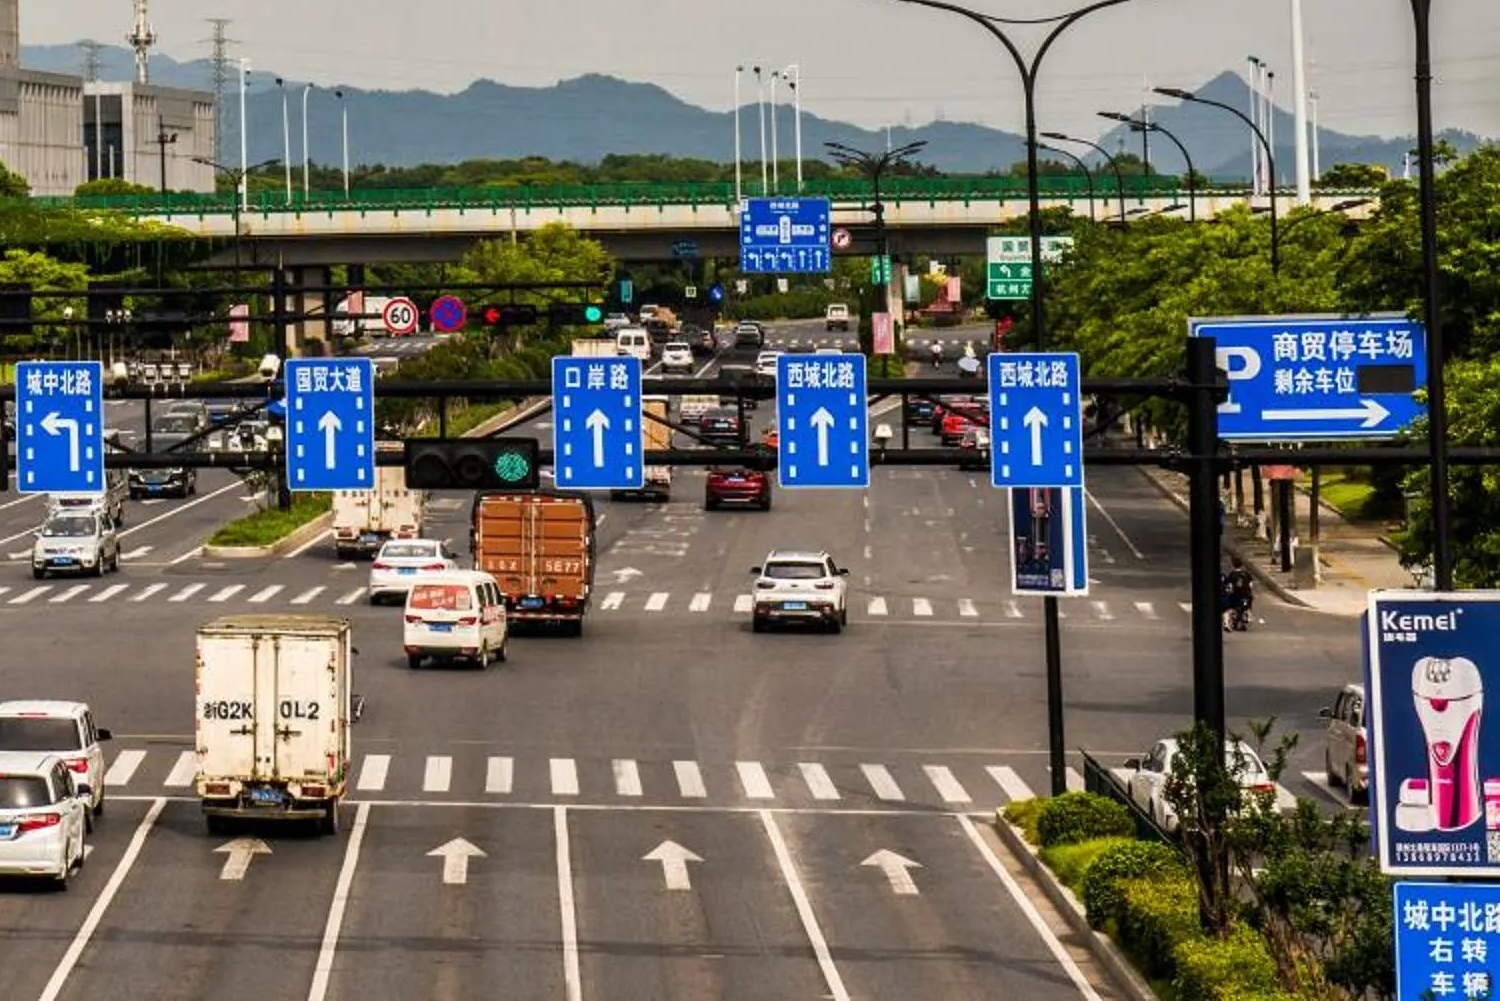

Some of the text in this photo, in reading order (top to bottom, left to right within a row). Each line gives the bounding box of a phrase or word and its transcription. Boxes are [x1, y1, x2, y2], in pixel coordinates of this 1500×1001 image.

[390, 307, 411, 324] 60
[1272, 330, 1413, 362] 商贸停车场
[26, 368, 92, 396] 城中北路
[296, 365, 362, 392] 国贸大道
[565, 363, 629, 390] 口岸路
[787, 362, 855, 388] 西城北路
[1000, 360, 1068, 387] 西城北路
[1274, 366, 1356, 395] 剩余车位
[1381, 610, 1457, 631] Kemei
[1428, 937, 1487, 963] 右转
[1430, 971, 1490, 998] 车辆
